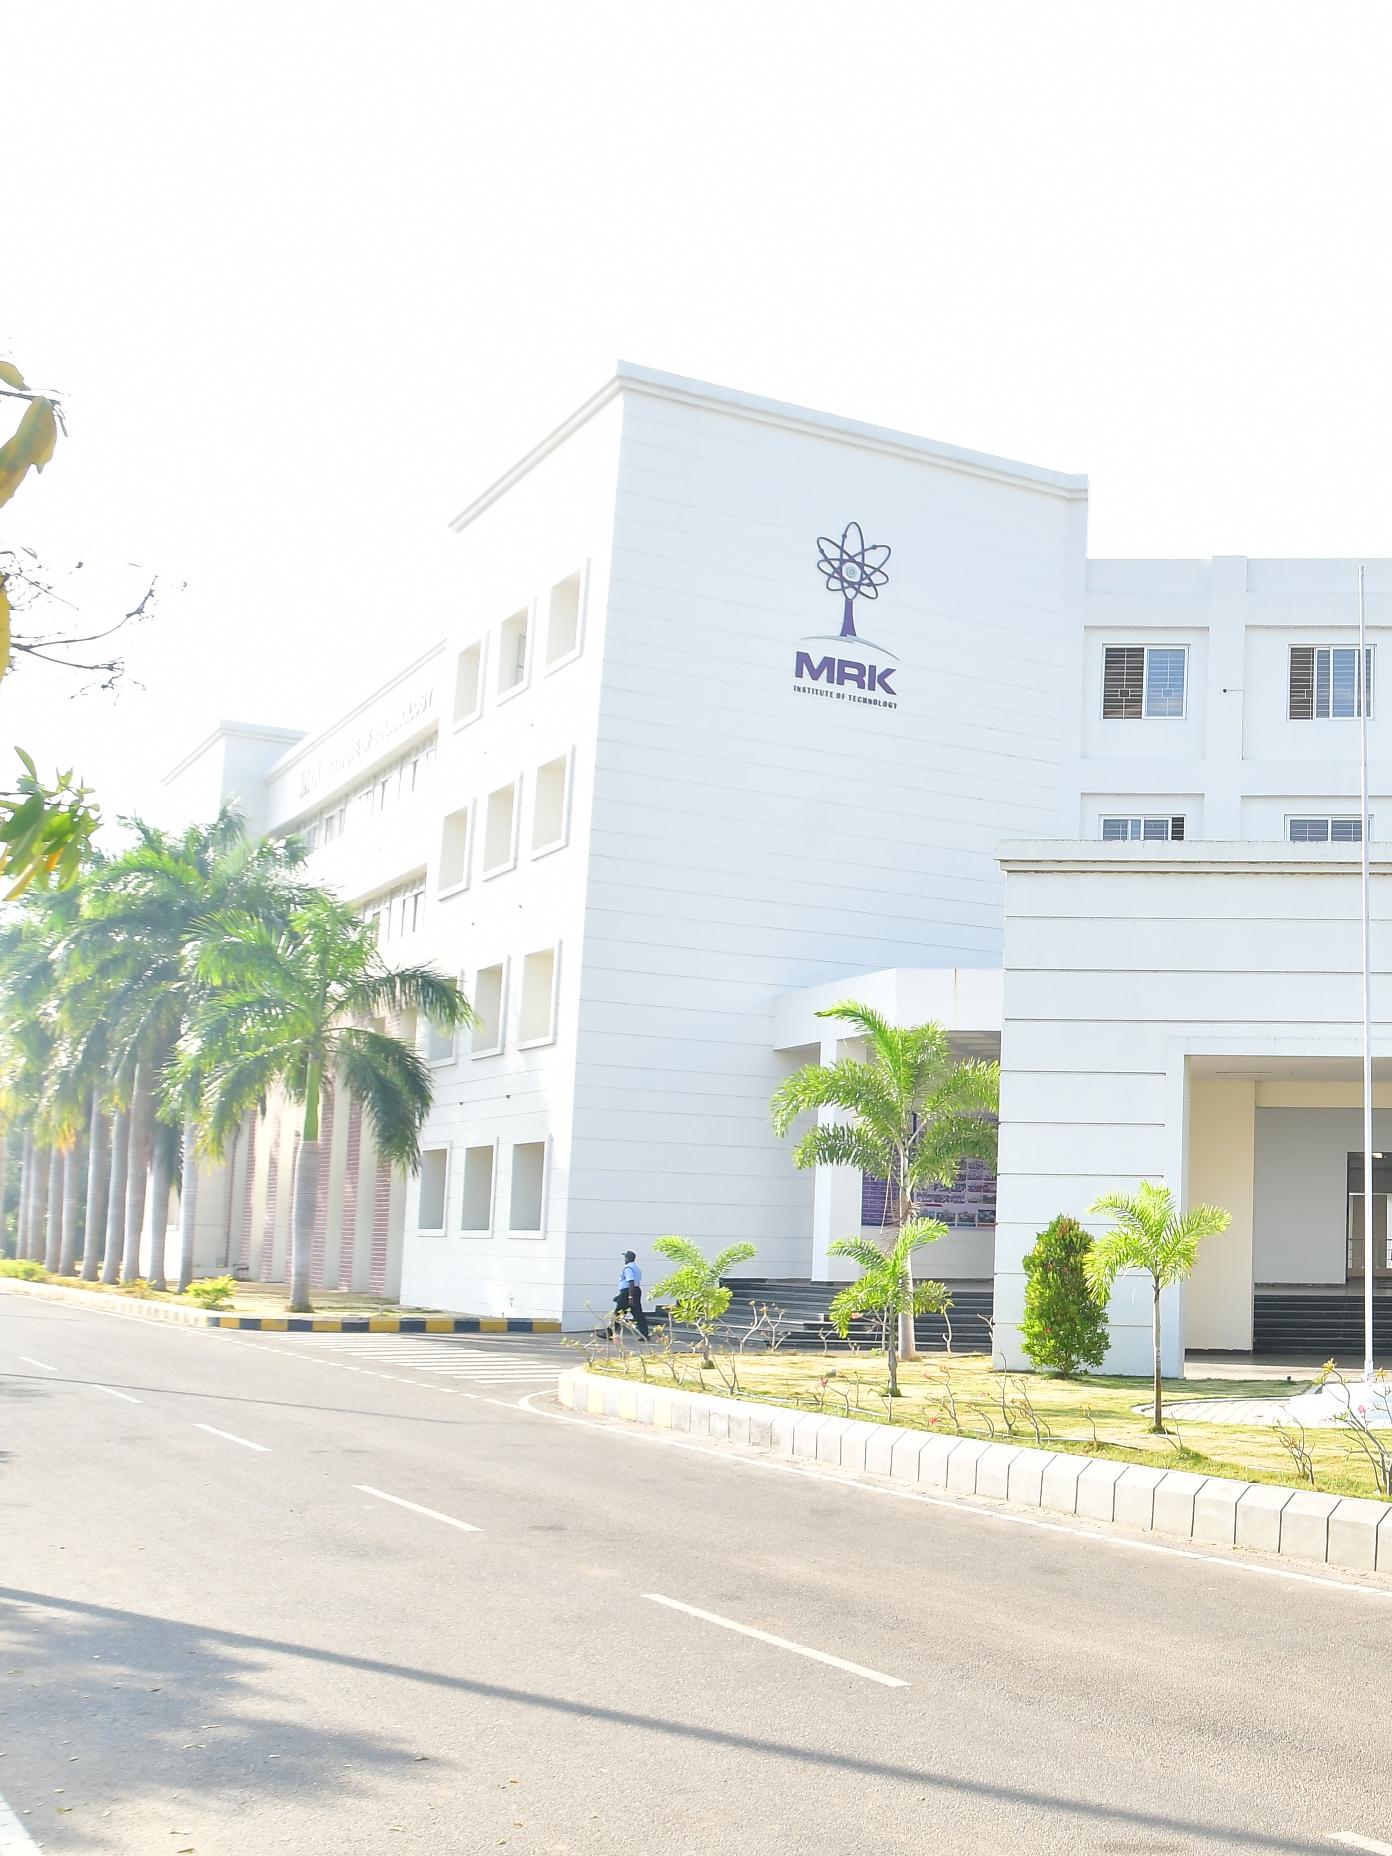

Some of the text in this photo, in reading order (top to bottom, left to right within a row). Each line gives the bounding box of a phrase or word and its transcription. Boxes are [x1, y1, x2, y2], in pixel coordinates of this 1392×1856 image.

[795, 651, 897, 695] MRK
[793, 685, 897, 709] INSTITUTE OF TECHNOLOGY
